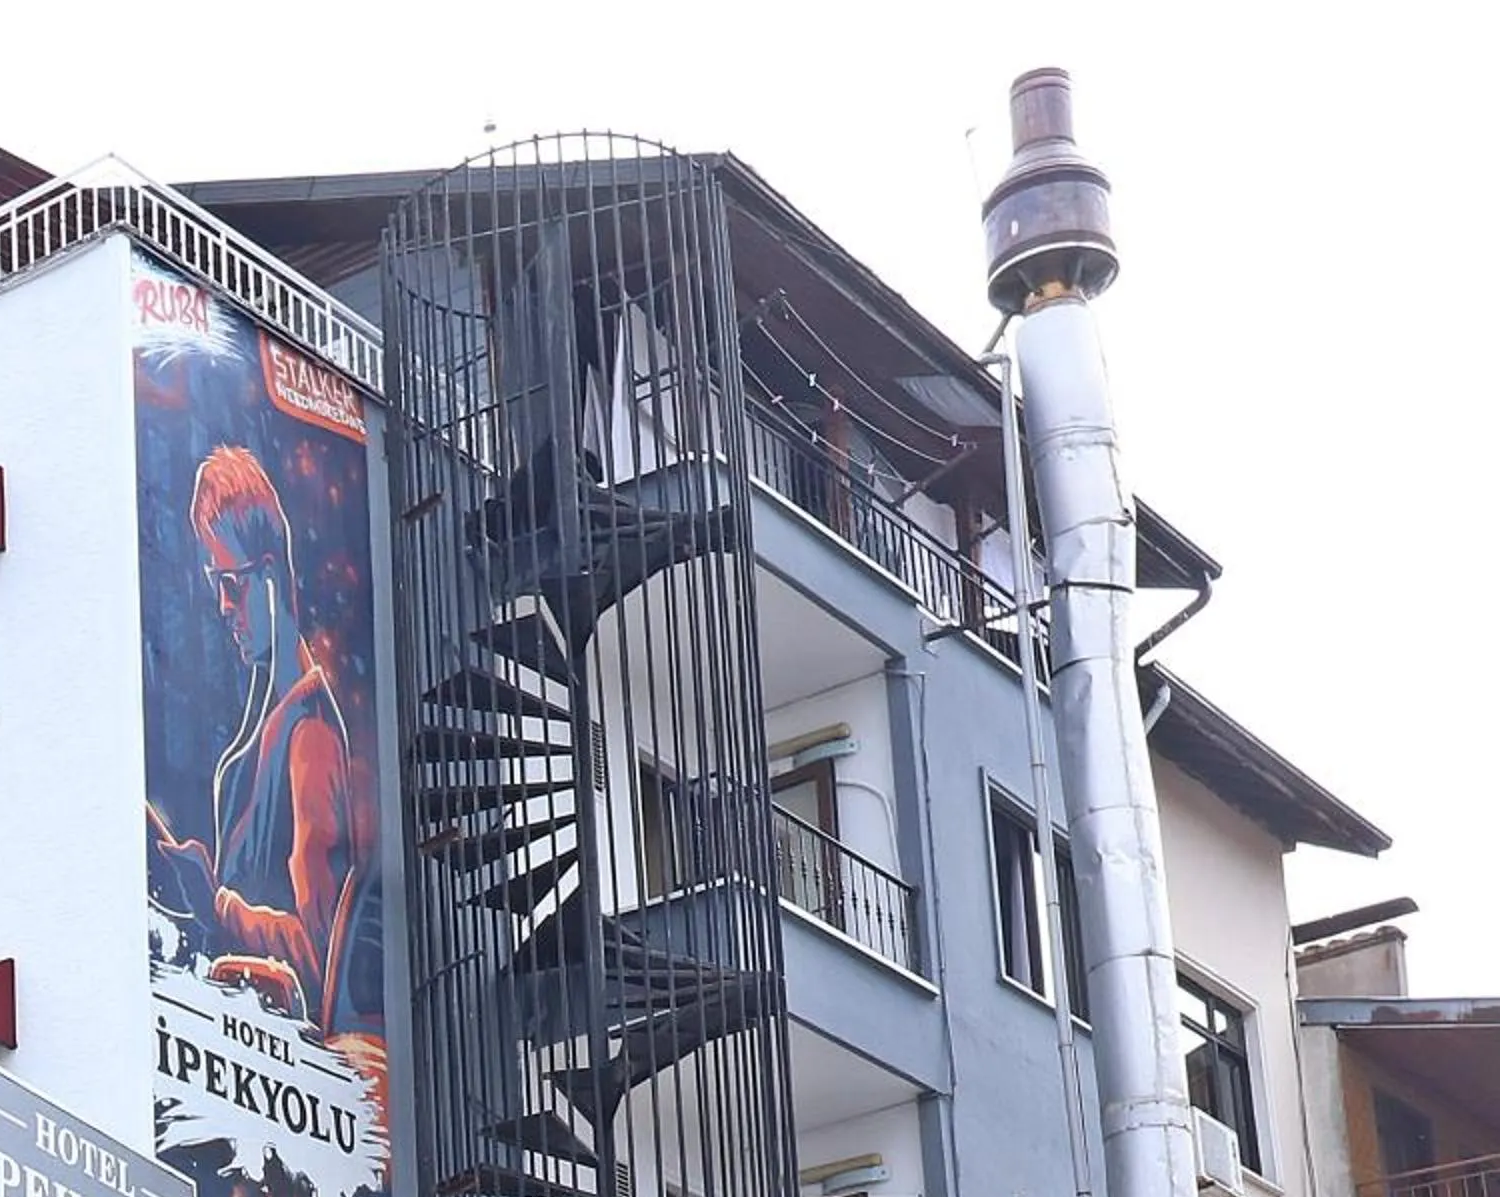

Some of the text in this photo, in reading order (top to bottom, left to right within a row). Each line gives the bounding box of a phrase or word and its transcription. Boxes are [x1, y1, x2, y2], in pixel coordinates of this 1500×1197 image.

[135, 278, 210, 332] RUBA
[223, 1014, 295, 1067] HOTEL
[156, 1015, 357, 1154] İPEKYOLU
